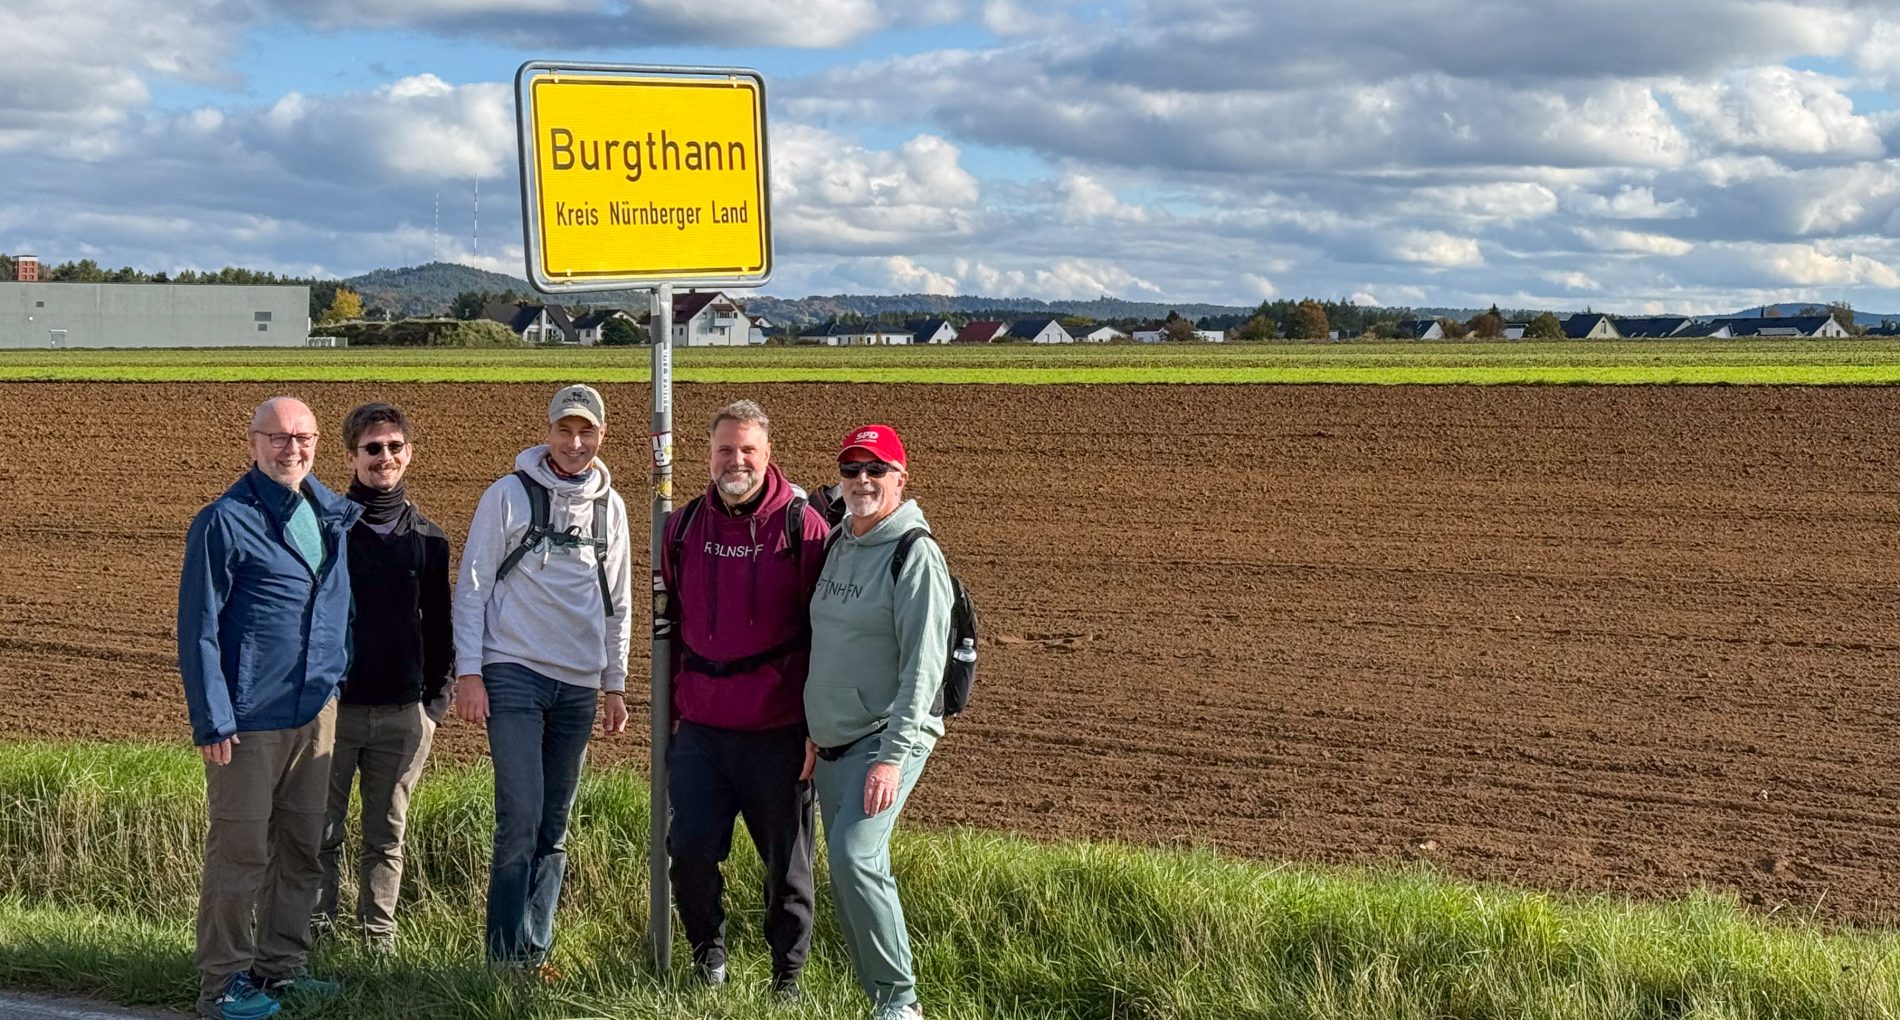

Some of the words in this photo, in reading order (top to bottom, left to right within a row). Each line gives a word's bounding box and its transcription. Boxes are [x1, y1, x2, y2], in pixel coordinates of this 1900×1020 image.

[551, 128, 746, 182] Burgthann
[556, 201, 599, 226] Kreis
[610, 201, 702, 230] Nürnberger
[711, 200, 748, 224] Land
[856, 431, 879, 440] SPD
